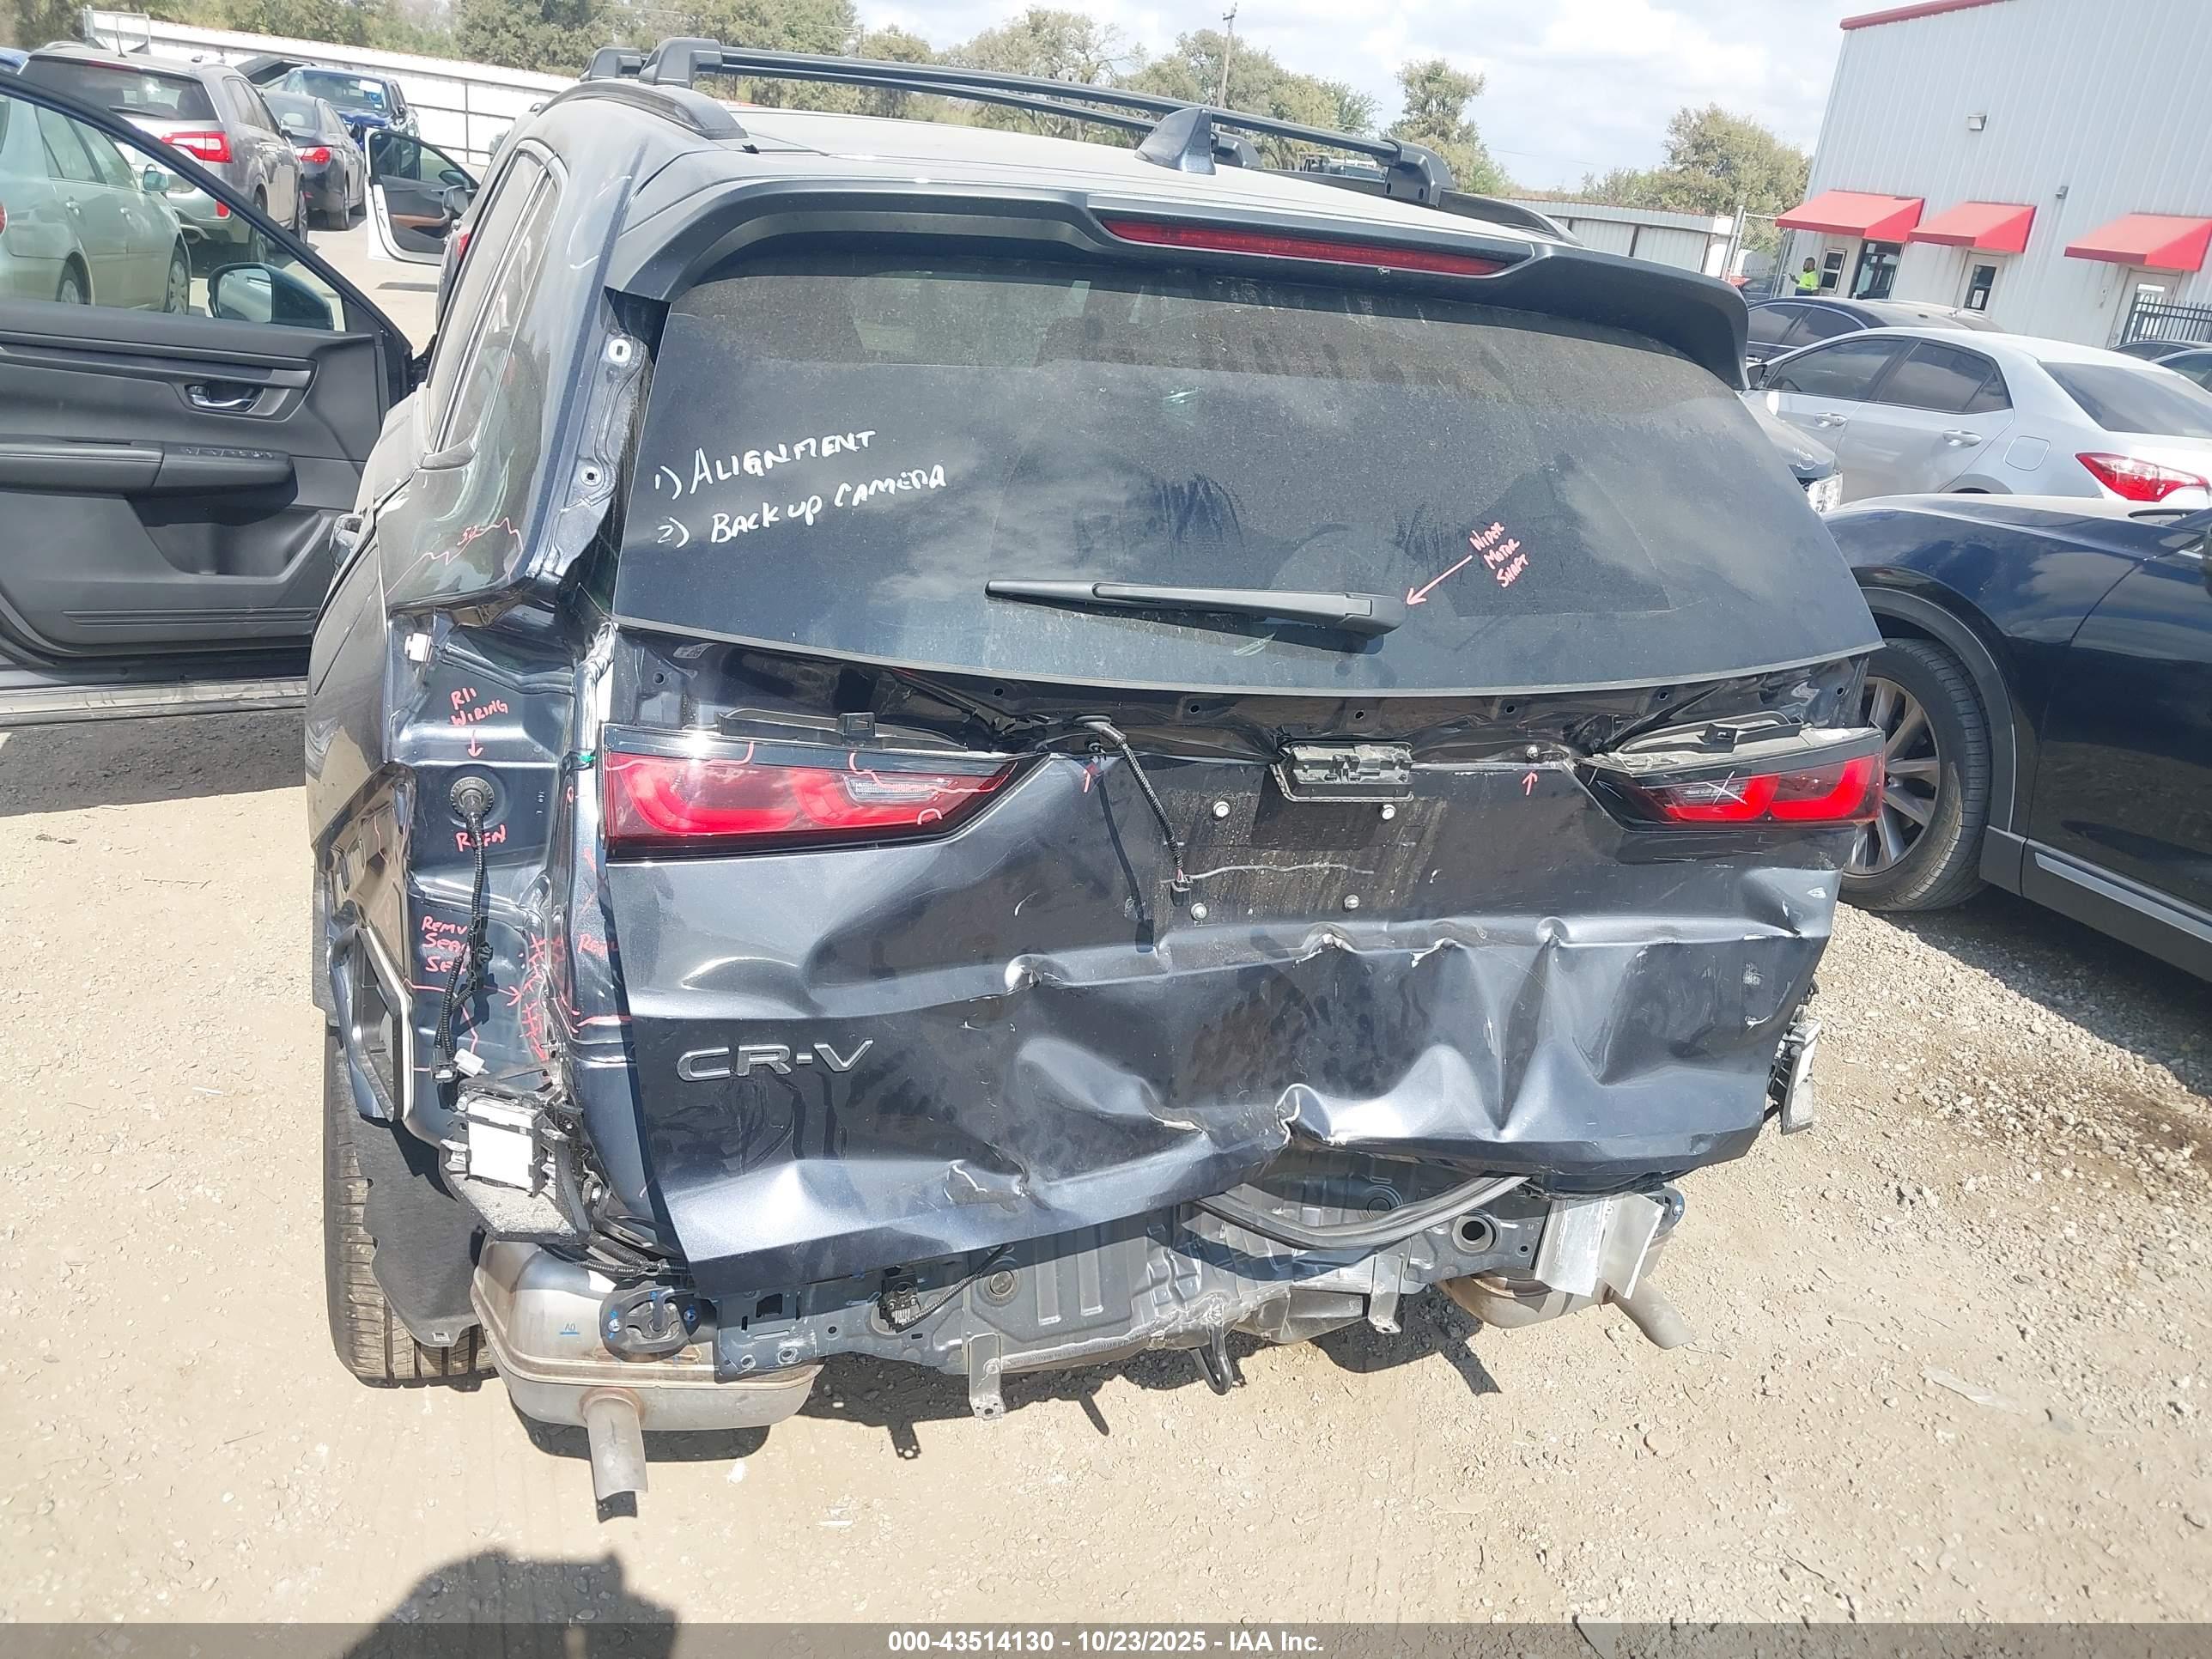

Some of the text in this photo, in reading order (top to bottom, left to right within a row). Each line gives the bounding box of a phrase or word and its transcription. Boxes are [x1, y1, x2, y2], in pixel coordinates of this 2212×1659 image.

[690, 430, 877, 495] ALIGNMENT
[834, 465, 947, 507] CAMERA
[676, 1037, 874, 1082] CR-V
